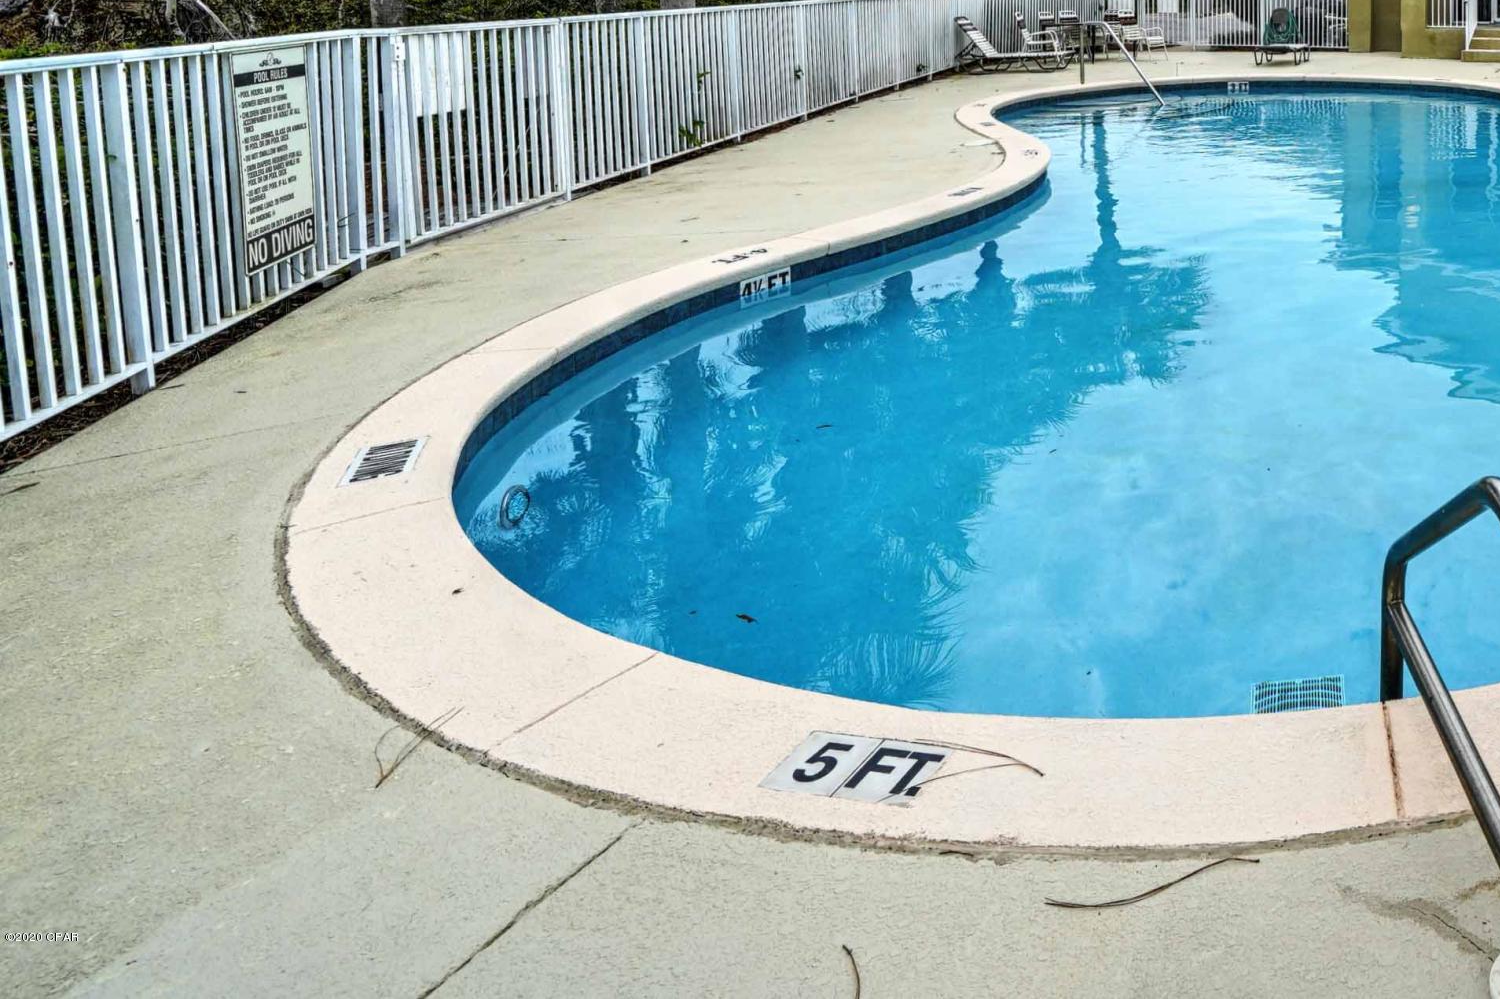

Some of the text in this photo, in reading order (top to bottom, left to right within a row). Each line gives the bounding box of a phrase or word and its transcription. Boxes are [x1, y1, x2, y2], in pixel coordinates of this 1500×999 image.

[254, 68, 288, 83] POOL RULES
[249, 219, 313, 268] NO DIVING
[792, 742, 855, 783] 5
